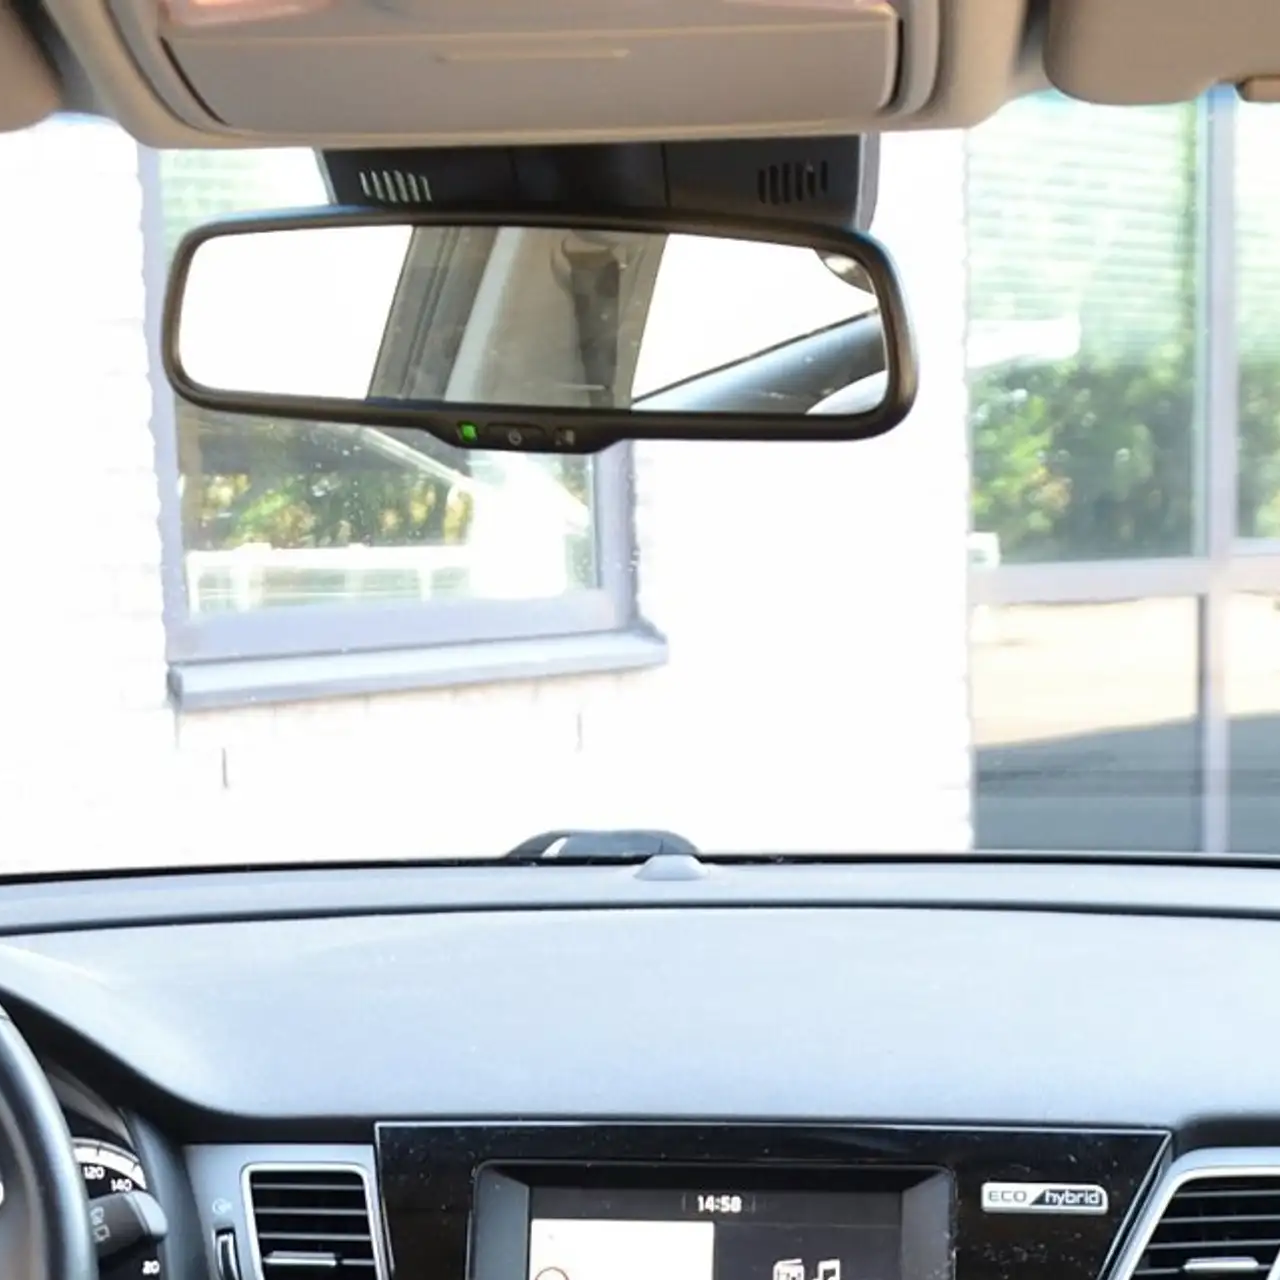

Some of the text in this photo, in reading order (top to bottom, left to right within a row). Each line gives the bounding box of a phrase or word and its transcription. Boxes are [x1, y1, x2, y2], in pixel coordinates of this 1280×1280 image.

[83, 1166, 105, 1180] 120
[110, 1178, 132, 1192] 140
[697, 1195, 742, 1213] 14:58
[988, 1189, 1100, 1205] ECO hybrid
